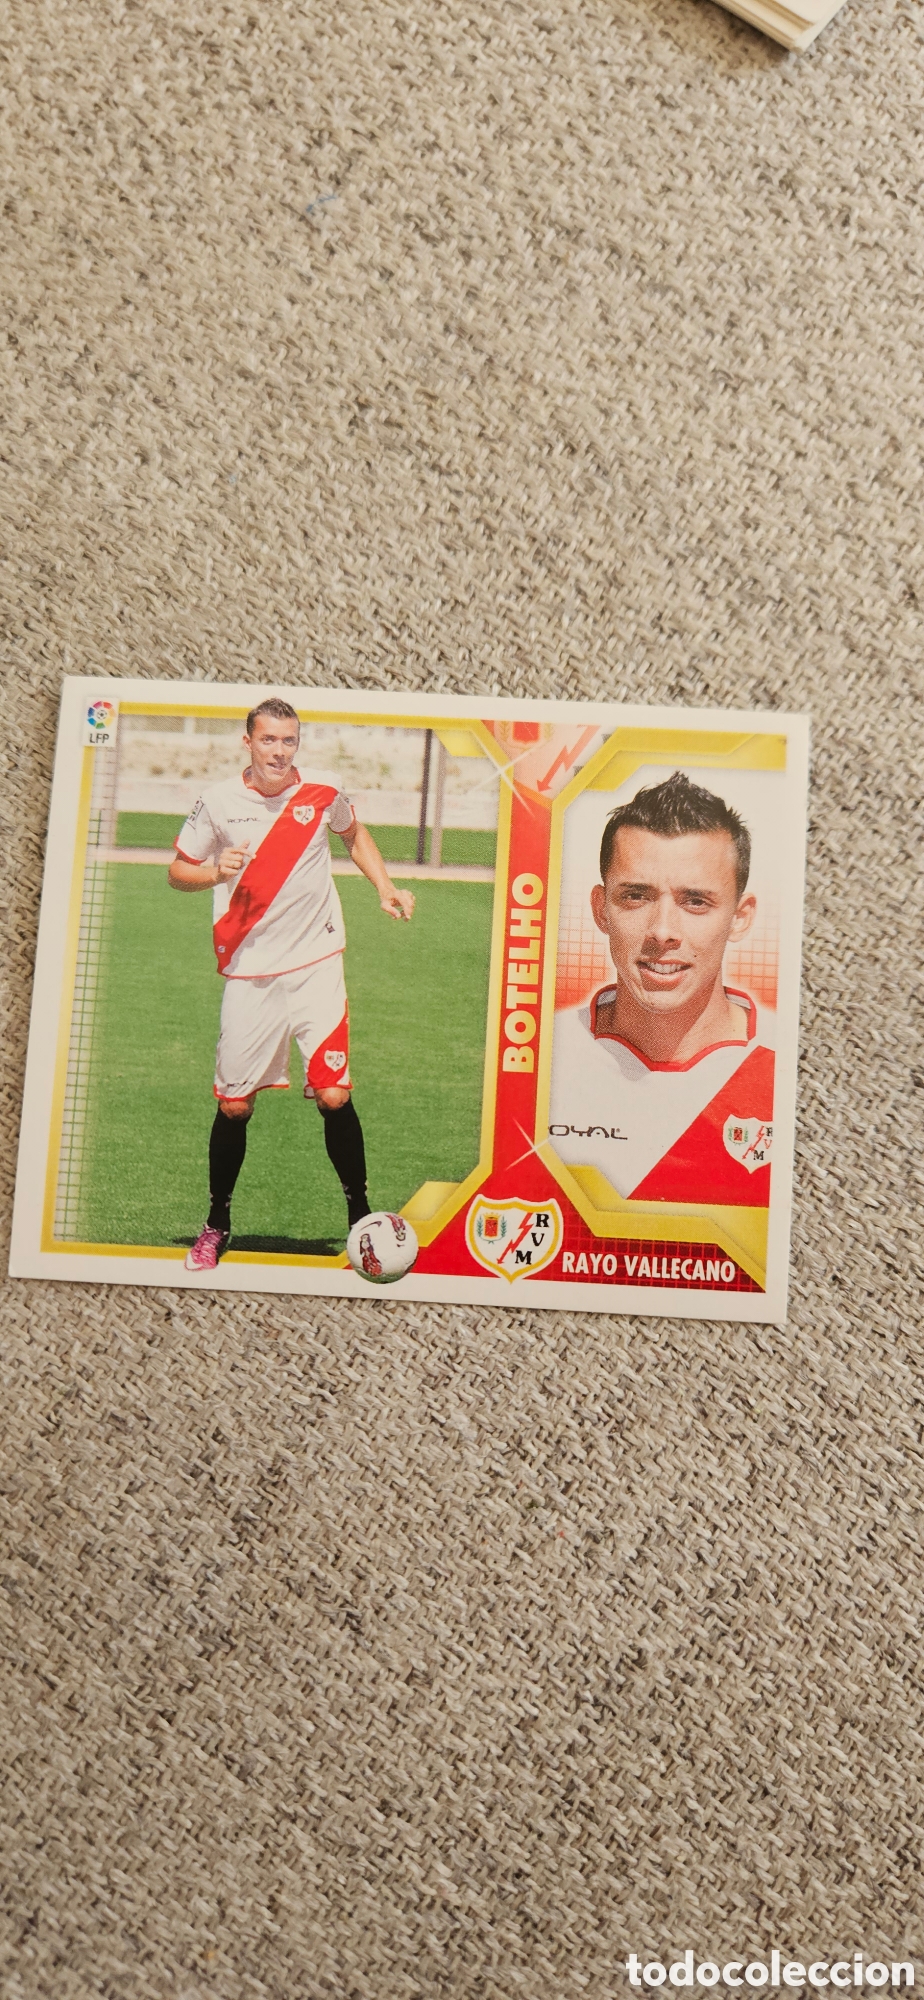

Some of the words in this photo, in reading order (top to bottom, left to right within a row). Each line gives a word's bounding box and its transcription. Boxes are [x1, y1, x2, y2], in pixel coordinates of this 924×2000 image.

[89, 733, 110, 744] LFP
[502, 872, 544, 1074] BOTELHO
[548, 1124, 628, 1140] OYAL
[562, 1251, 618, 1276] RAYO
[624, 1255, 736, 1283] VALLECANO
